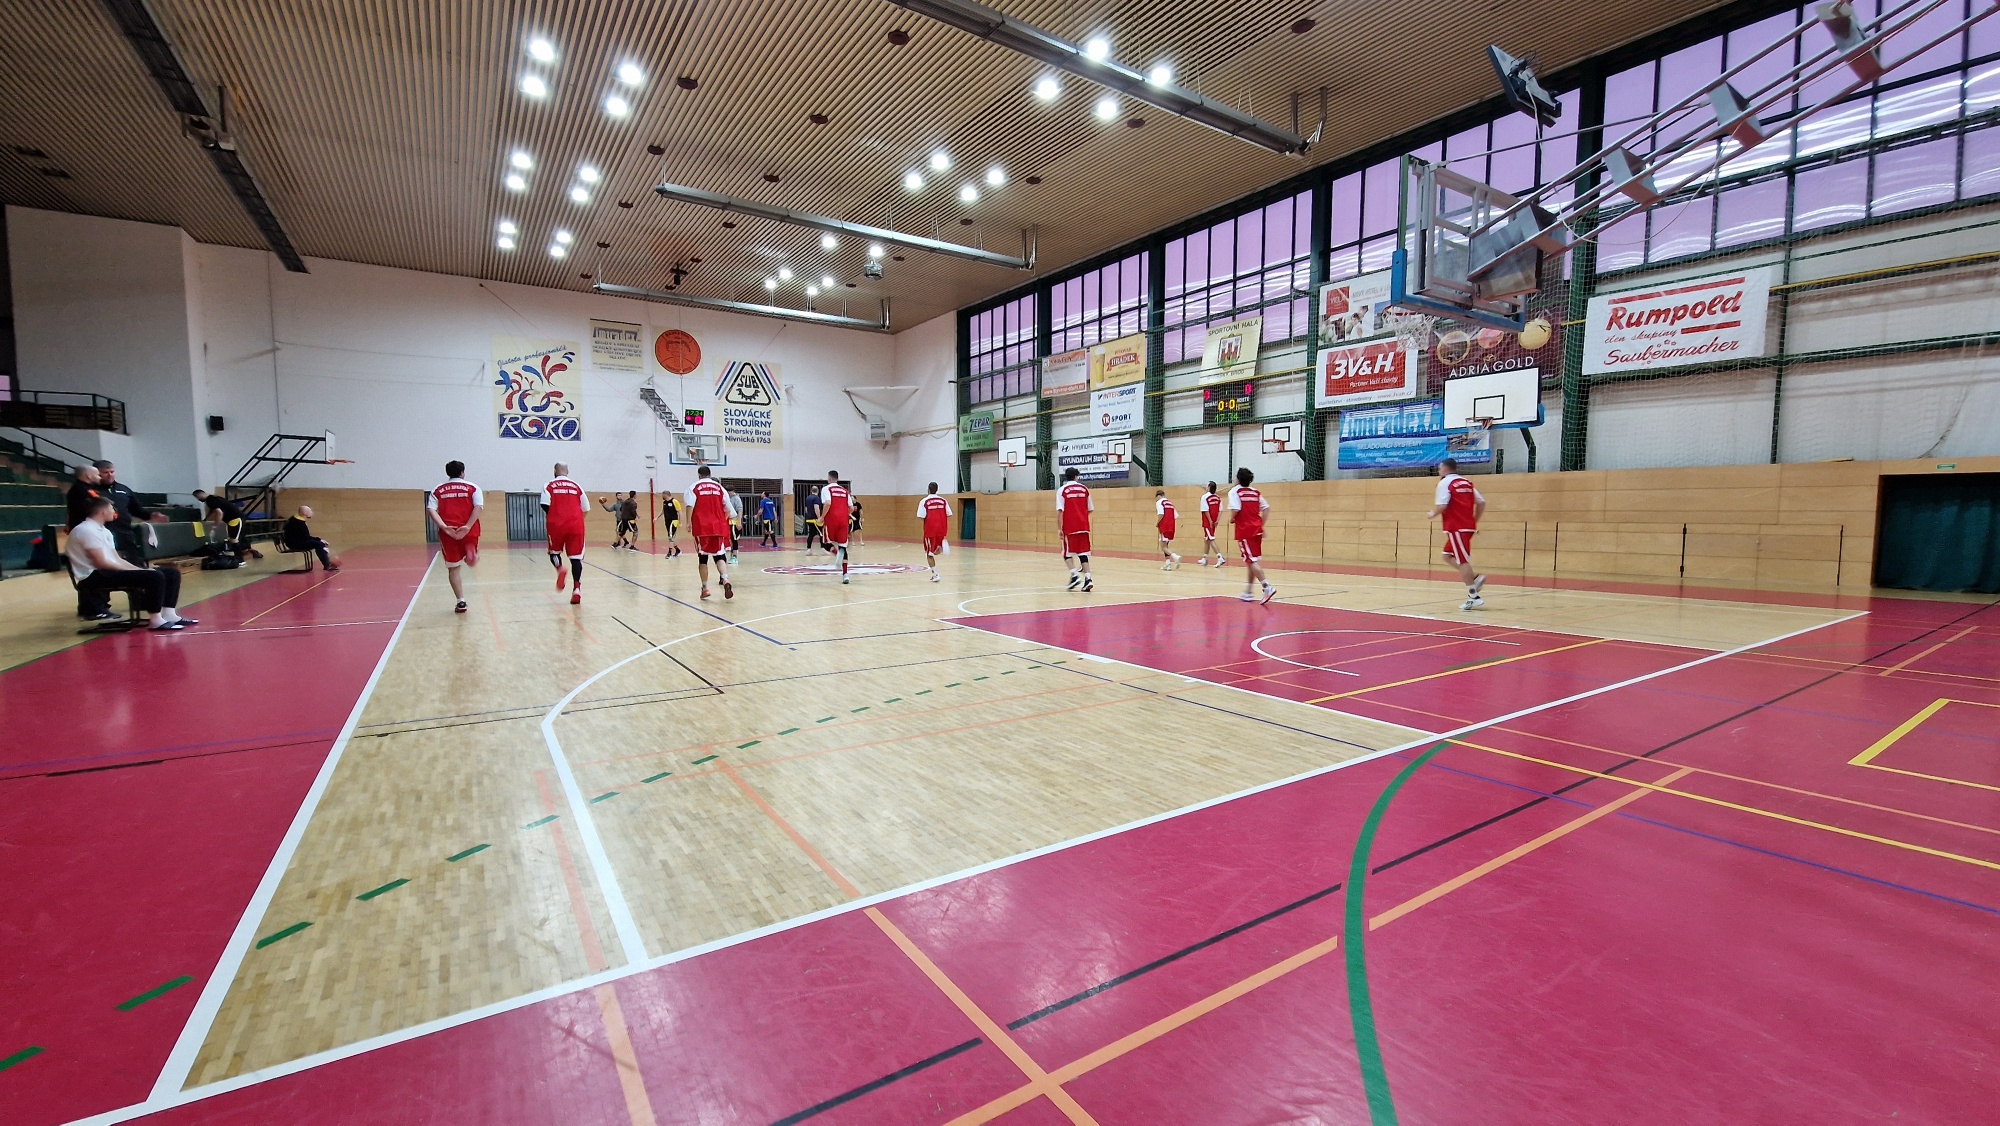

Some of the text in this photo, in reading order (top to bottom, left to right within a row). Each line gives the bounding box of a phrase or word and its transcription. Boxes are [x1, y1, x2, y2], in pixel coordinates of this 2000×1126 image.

[1605, 290, 1743, 331] Rumpold
[1208, 319, 1258, 336] SPORTOVNÍ HALA
[1604, 328, 1678, 344] člen skupiny
[1603, 336, 1740, 365] Saubermacher
[737, 374, 760, 389] SUB
[1350, 380, 1369, 388] Partner
[1380, 375, 1399, 384] stavby
[1103, 387, 1137, 400] INTERSPORT
[723, 408, 772, 419] SLOVÁCKÉ
[1111, 413, 1131, 422] SPORT
[499, 414, 580, 440] ROKO
[723, 417, 772, 428] STROJÍRNY
[724, 427, 754, 436] Uherský
[725, 435, 772, 444] Nivnická 1763
[1062, 455, 1085, 465] HYUNDAI
